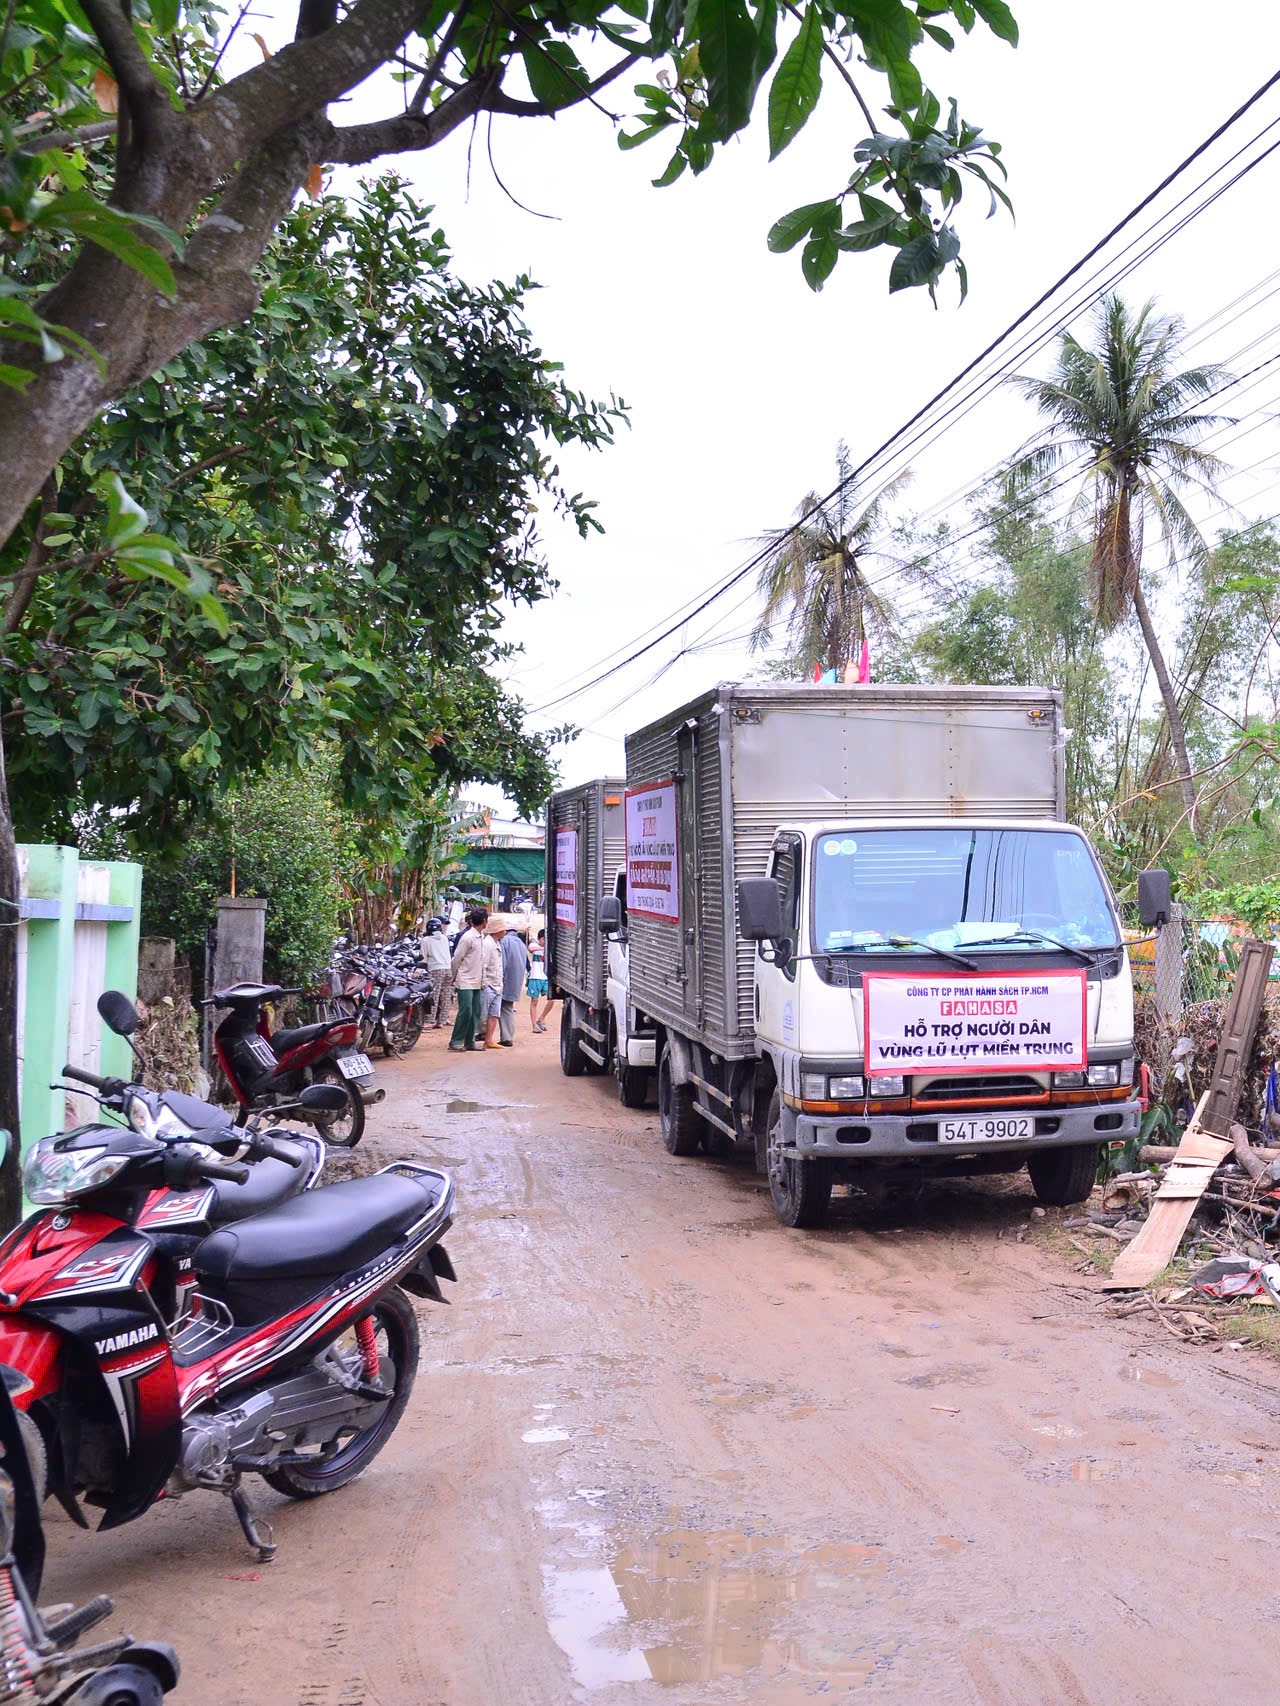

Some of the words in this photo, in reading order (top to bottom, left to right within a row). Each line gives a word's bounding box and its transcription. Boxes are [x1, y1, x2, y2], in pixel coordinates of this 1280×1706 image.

[907, 986, 928, 997] CÔNG
[931, 988, 939, 996] TY
[941, 988, 952, 996] CP
[976, 985, 996, 996] HÀNH
[999, 985, 1018, 995] SÁCH
[1021, 986, 1048, 995] TP.HCM
[941, 1000, 1017, 1015] FAHASA
[904, 1018, 927, 1037] HỖ
[931, 1022, 963, 1040] TRỢ
[967, 1020, 1014, 1036] NGƯỜI
[1019, 1019, 1051, 1035] DÂN
[879, 1042, 923, 1058] VÙNG
[927, 1042, 946, 1057] LŨ
[951, 1044, 979, 1060] LỤT
[983, 1039, 1020, 1056] MIỀN
[1024, 1042, 1073, 1055] TRUNG
[944, 1119, 1029, 1140] 54T-9902
[95, 1323, 159, 1355] YAMAHA
